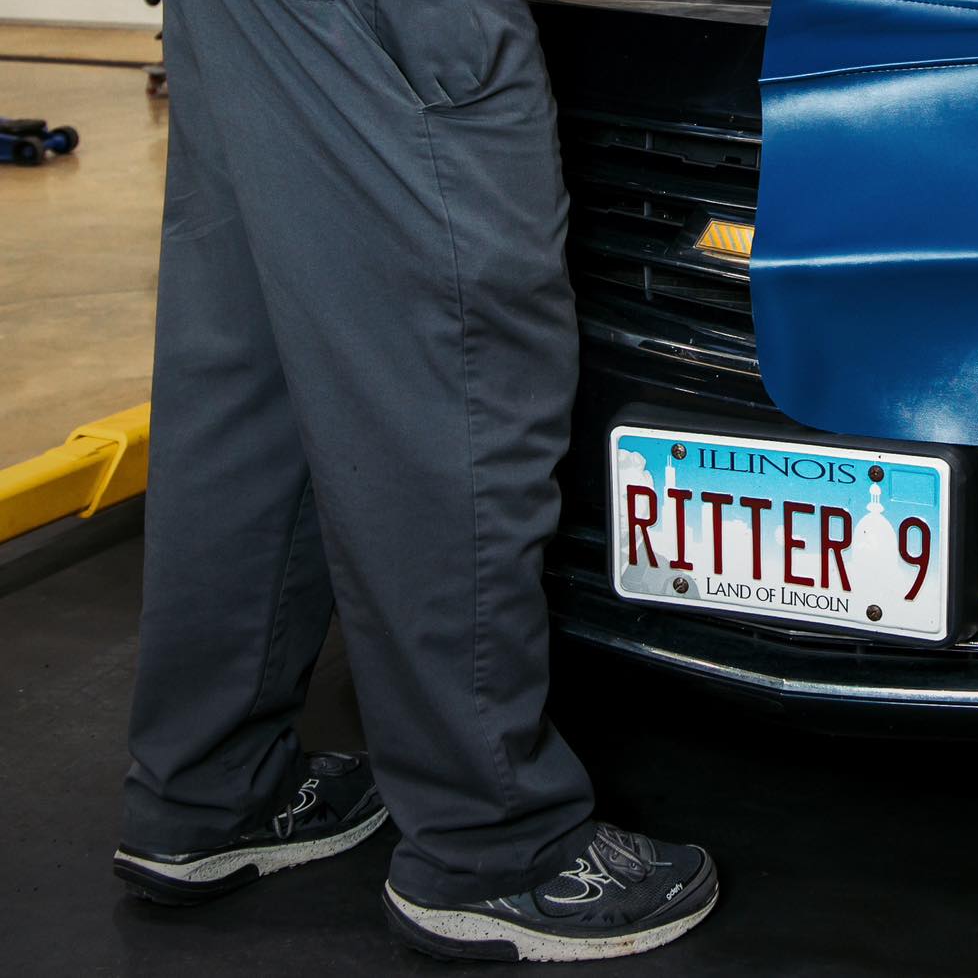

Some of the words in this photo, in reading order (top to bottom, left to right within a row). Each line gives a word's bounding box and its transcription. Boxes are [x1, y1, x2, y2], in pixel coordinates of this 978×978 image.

[698, 447, 857, 484] ILLINOIS
[626, 484, 852, 592] RITTER
[898, 516, 931, 601] 9
[706, 577, 752, 600] LAND
[756, 585, 776, 603] OF
[781, 586, 850, 614] LINCOLN
